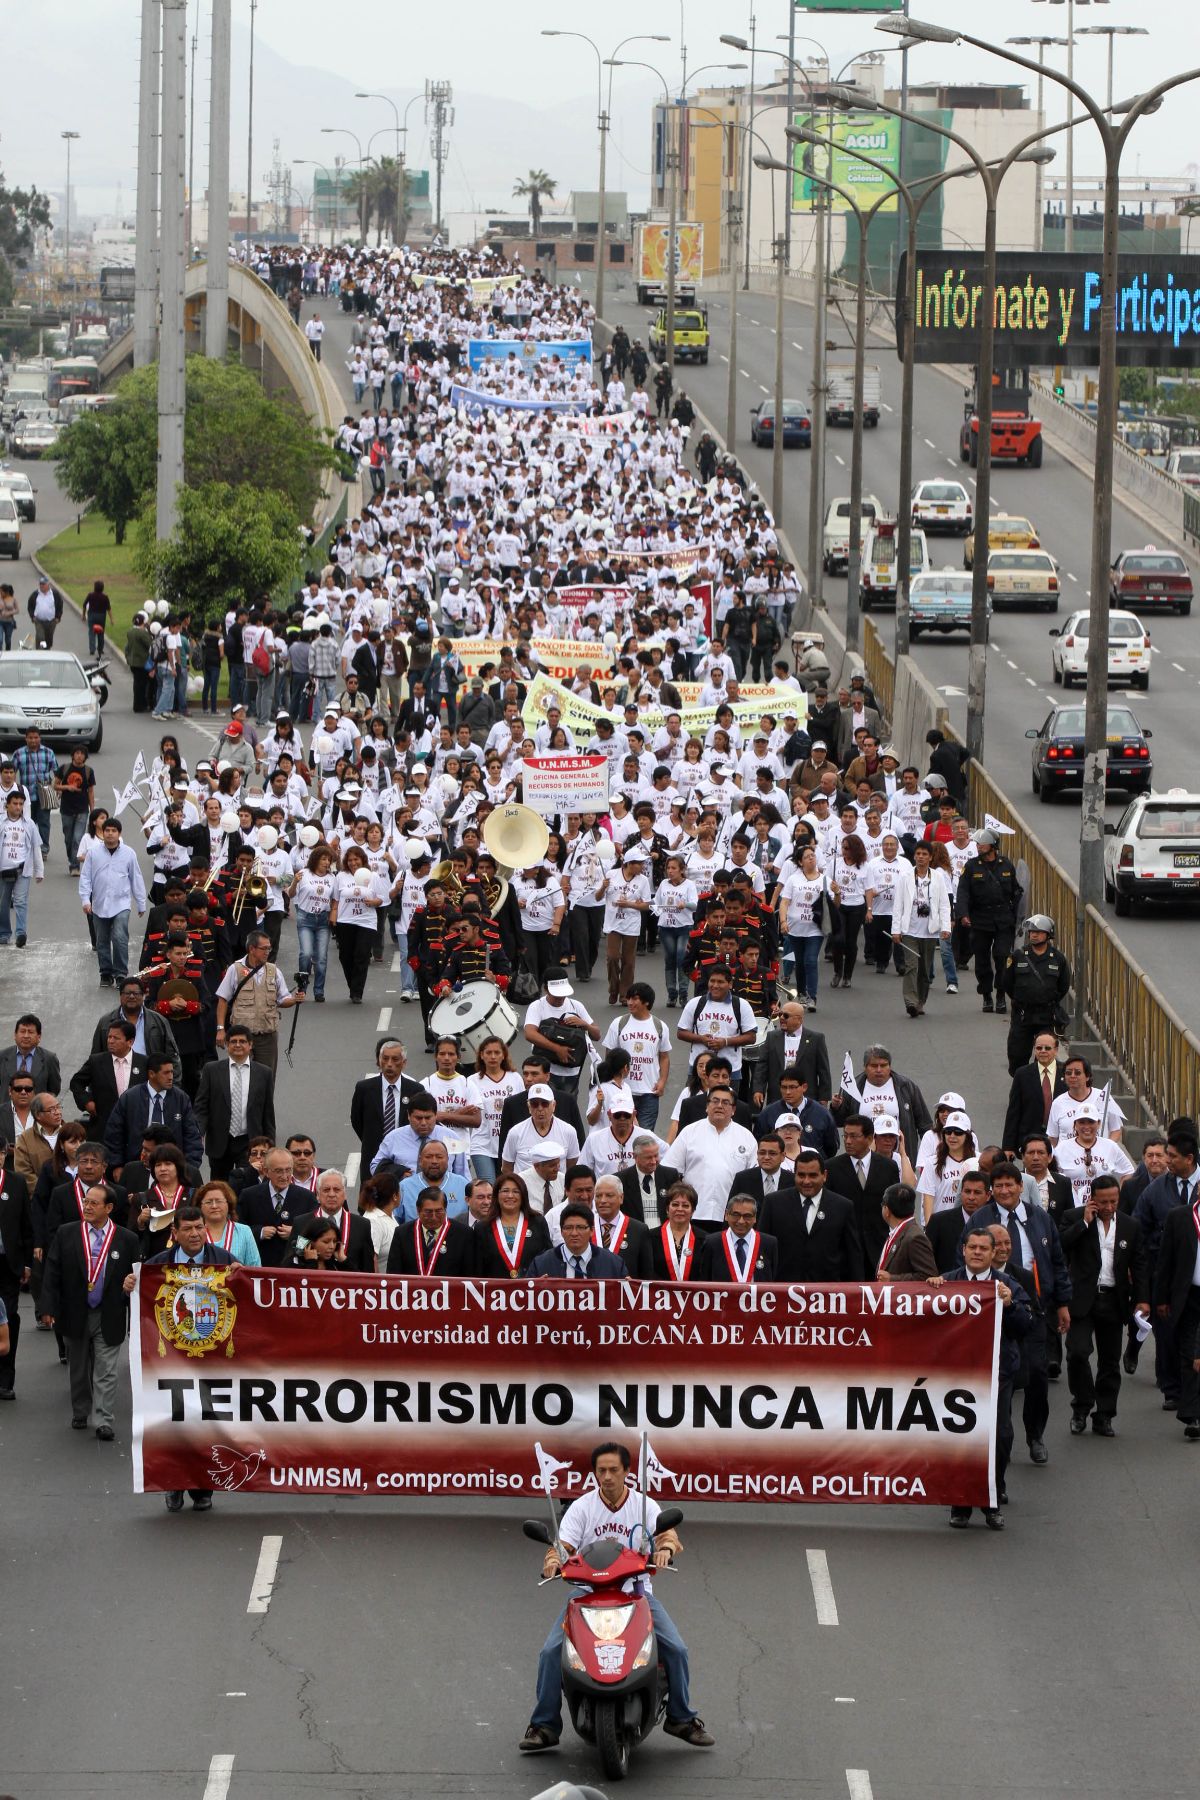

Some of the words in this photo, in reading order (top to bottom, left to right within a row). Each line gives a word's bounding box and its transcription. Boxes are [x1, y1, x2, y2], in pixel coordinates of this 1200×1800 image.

[846, 132, 887, 148] AQUÍ
[916, 269, 1049, 330] Infórmate
[1057, 288, 1076, 346] y
[1084, 271, 1200, 347] Prticipa
[533, 641, 570, 651] MAYOR
[573, 643, 583, 651] DE
[538, 759, 594, 770] U.N.M.S.M.
[555, 801, 577, 810] MAS
[8, 852, 18, 860] PAZ
[698, 1012, 733, 1024] UNMSM
[621, 1031, 658, 1044] UNMSM
[632, 1063, 642, 1072] DE
[629, 1071, 643, 1081] PAZ
[436, 1095, 467, 1107] NMSM
[864, 1095, 895, 1104] UNMSM
[491, 1128, 502, 1138] PA
[607, 1151, 636, 1162] UNMS
[1073, 1155, 1105, 1166] UNSM
[250, 1278, 451, 1312] Universidad
[461, 1280, 607, 1312] Nacional
[617, 1280, 729, 1320] Mayor
[738, 1284, 778, 1315] de
[787, 1284, 848, 1316] San
[858, 1285, 983, 1317] Marcos
[360, 1323, 490, 1345] Universidad
[496, 1324, 528, 1345] del
[535, 1324, 593, 1349] Perú,
[598, 1324, 704, 1346] DECANA
[710, 1324, 745, 1346] DE
[751, 1320, 873, 1347] AMÉRICA
[157, 1377, 575, 1426] TERRORISMO
[598, 1384, 825, 1431] NUNCA
[846, 1376, 978, 1434] MÁS
[270, 1467, 368, 1491] UNMSM,
[376, 1472, 524, 1492] compromiso
[567, 1471, 599, 1491] PA
[670, 1474, 805, 1496] VIOLENCIA
[812, 1471, 928, 1497] POLÍTICA
[594, 1522, 631, 1538] UNMSM
